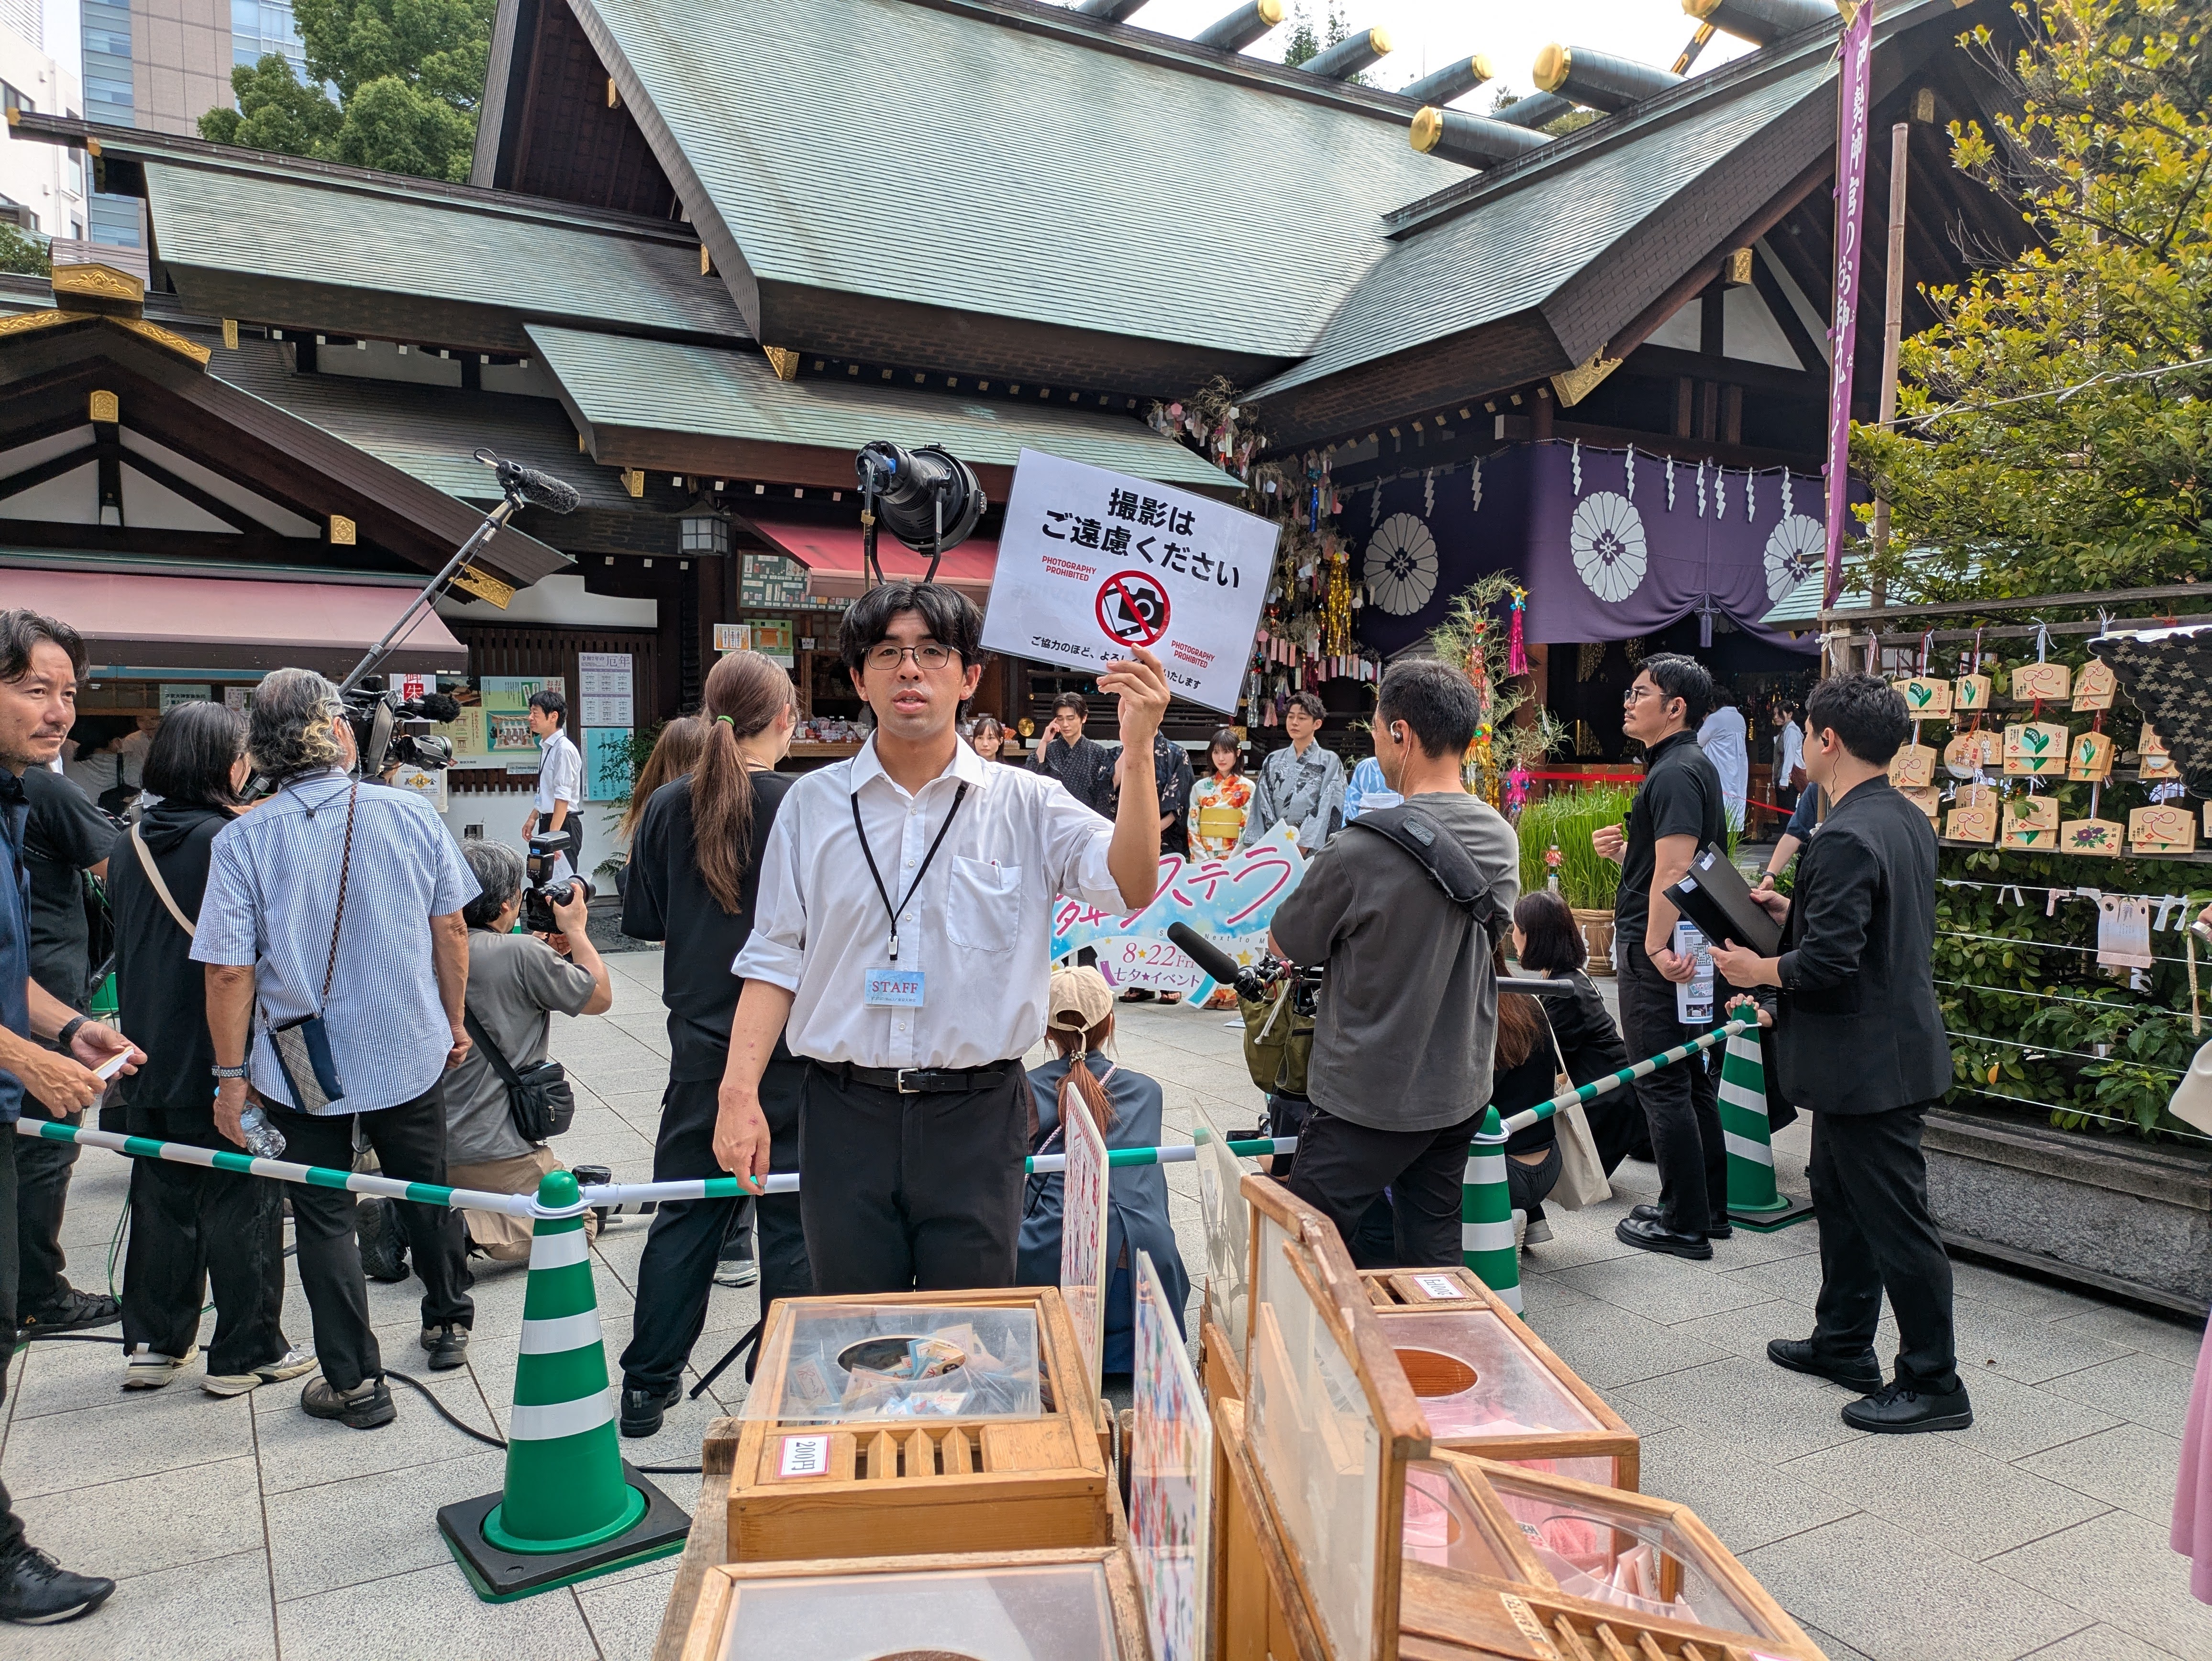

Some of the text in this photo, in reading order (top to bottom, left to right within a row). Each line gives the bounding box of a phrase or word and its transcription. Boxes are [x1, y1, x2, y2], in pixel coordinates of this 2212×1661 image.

[1107, 487, 1195, 536] 撮影は
[1042, 510, 1239, 588] ご遠慮ください
[1042, 555, 1097, 575] PHOTOGRAPHY
[1046, 565, 1089, 582] PROHIBITED
[1172, 640, 1216, 662] PHOTOGRAPHY
[1174, 650, 1208, 668] PROHIBITED
[607, 655, 630, 667] 厄年
[1971, 748, 1978, 760] 開運
[2112, 827, 2117, 838] 祈願
[1204, 933, 1230, 941] Next
[872, 981, 918, 994] STAFF
[1423, 1279, 1453, 1296] 200円
[791, 1441, 816, 1471] 200円
